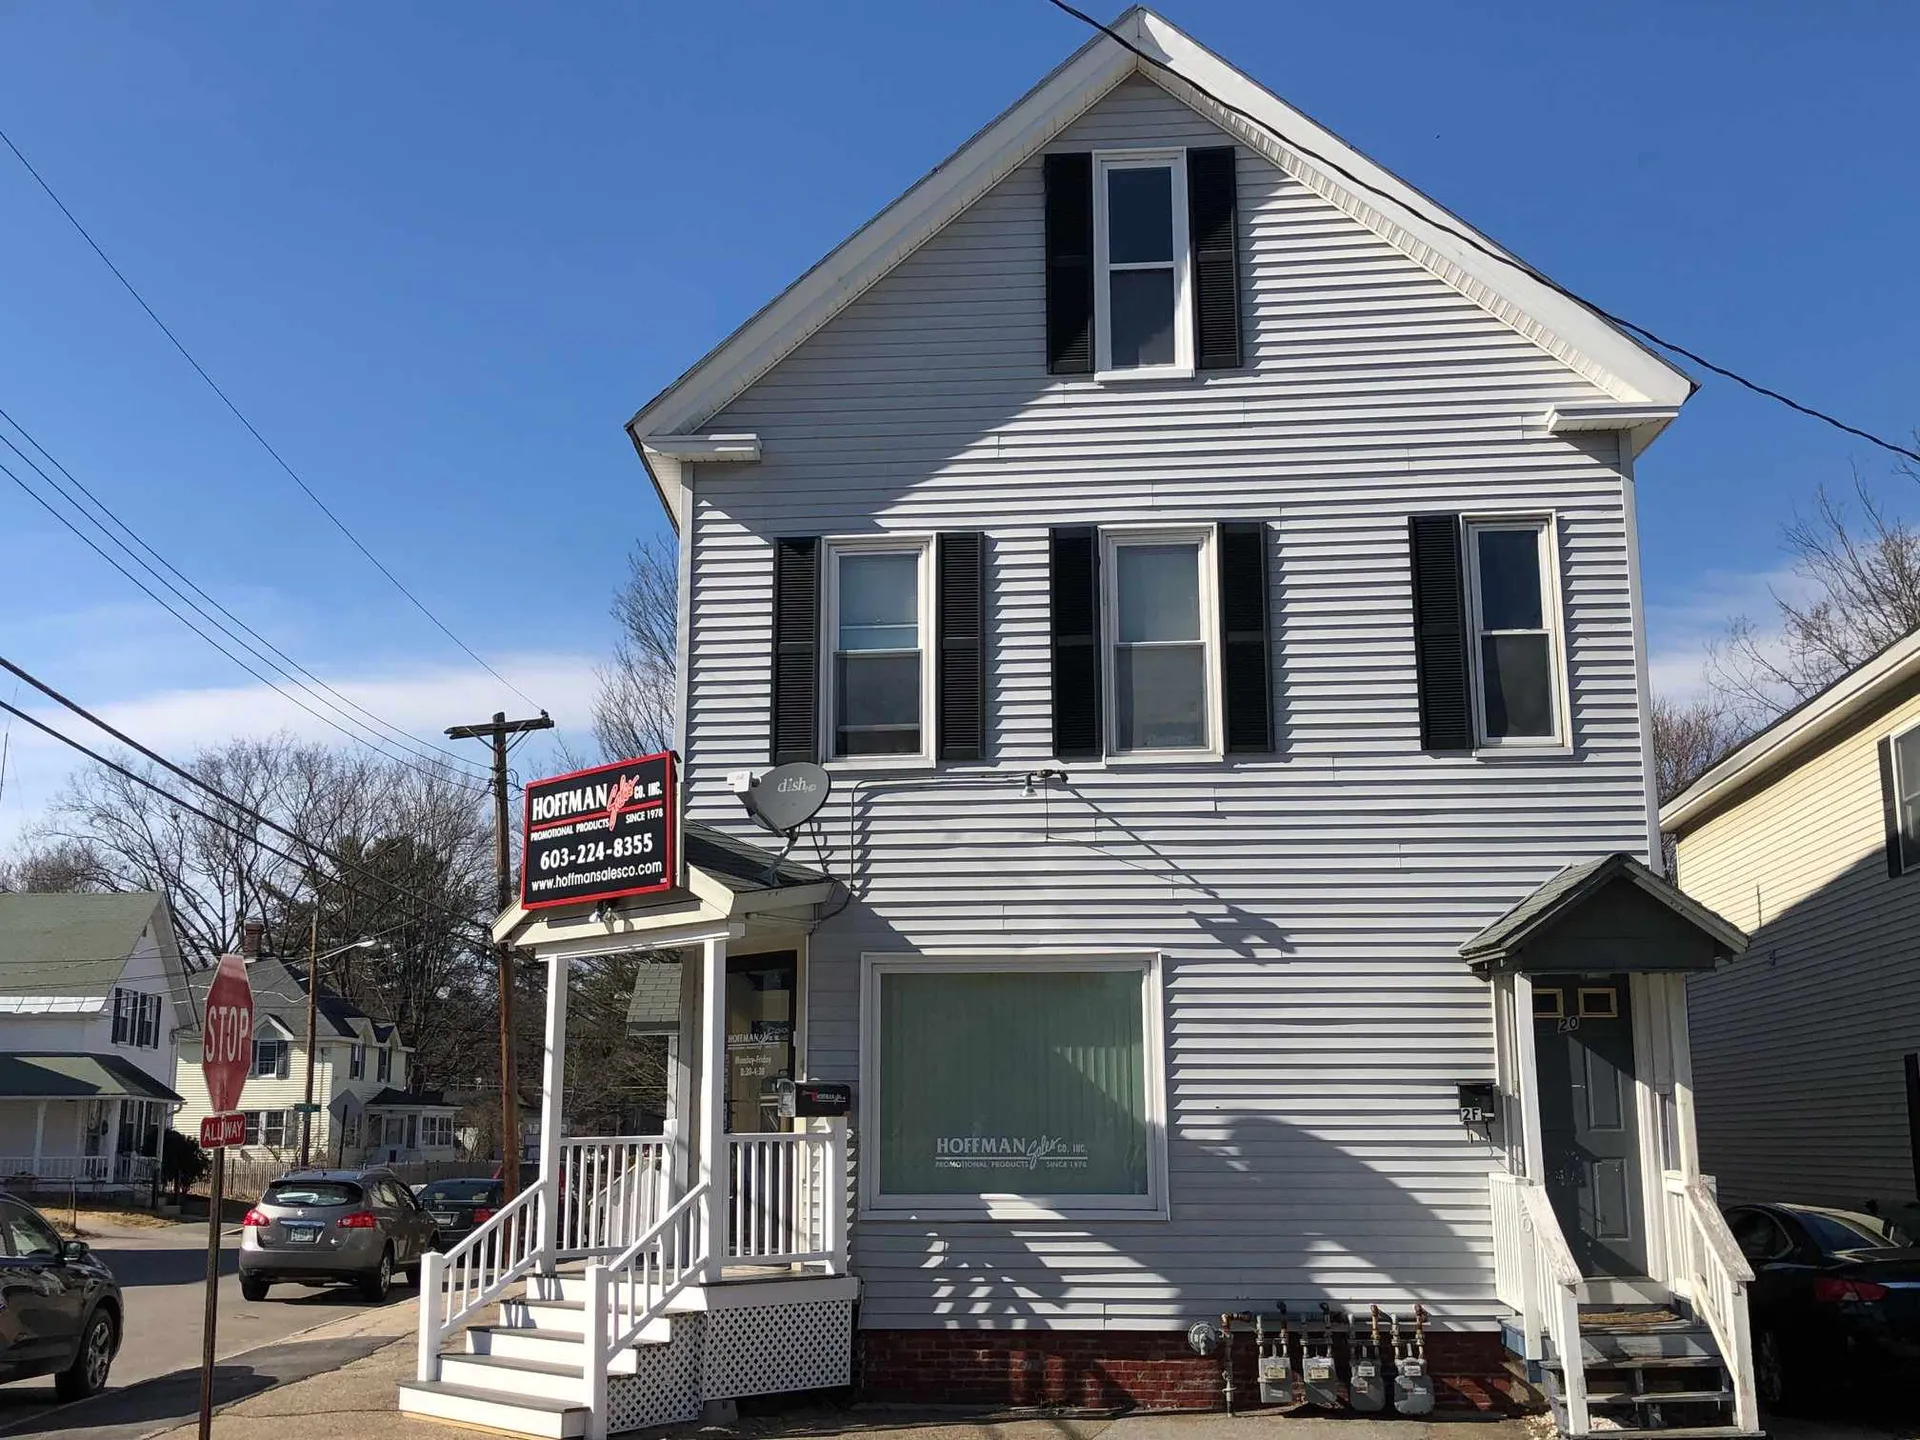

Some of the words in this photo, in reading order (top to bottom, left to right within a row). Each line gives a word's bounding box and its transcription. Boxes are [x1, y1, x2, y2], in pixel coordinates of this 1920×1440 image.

[777, 776, 807, 793] dish
[532, 783, 607, 821] HOFFMAN
[634, 785, 645, 800] CO.
[648, 781, 663, 797] INC.
[625, 811, 645, 824] SINCE
[647, 808, 663, 820] 1978
[530, 825, 573, 842] PROMOTIONAL
[576, 818, 610, 834] PRODUCTS
[540, 832, 653, 870] 603-224-8355
[531, 860, 662, 892] www.hoffmansalesco.com
[1559, 1016, 1578, 1032] 20
[206, 1005, 249, 1063] STOP
[1462, 1108, 1480, 1121] 2F
[203, 1122, 223, 1141] ALL
[224, 1120, 243, 1140] WAY
[936, 1137, 1026, 1153] HOFFMAN
[1072, 1143, 1088, 1154] INC.
[935, 1160, 988, 1168] PROMOTIONAL
[991, 1160, 1029, 1168] PRODUCTS
